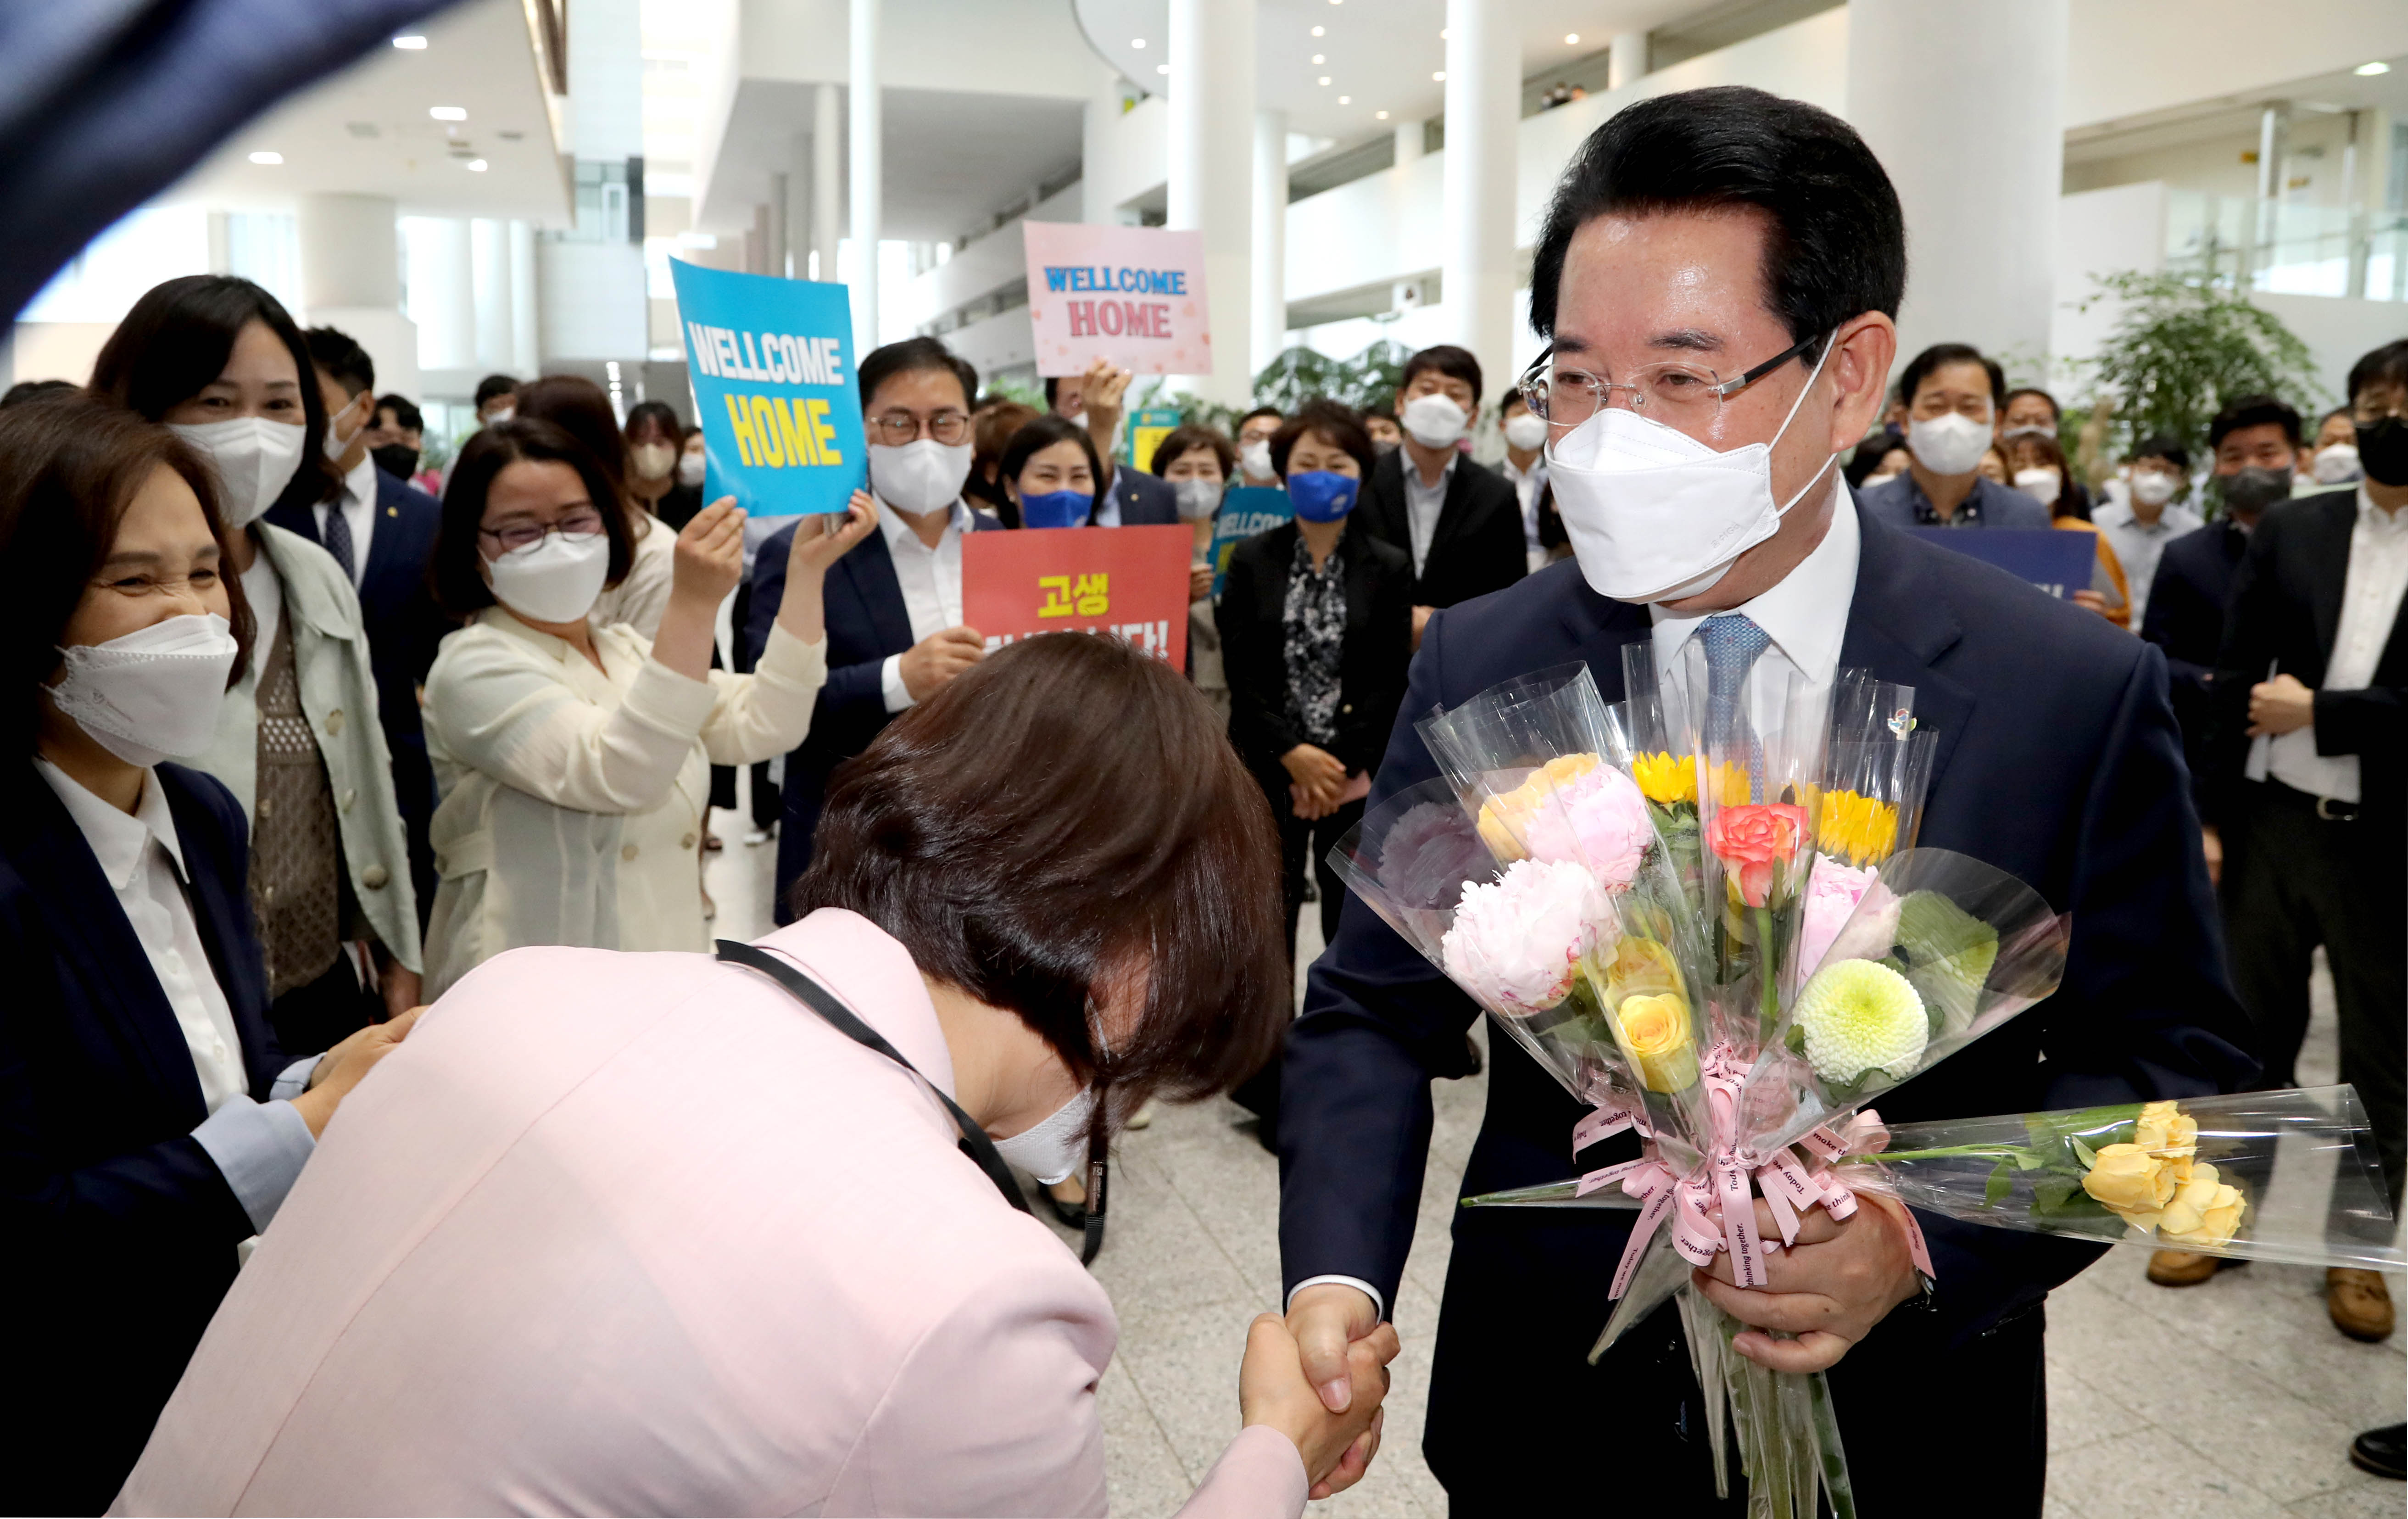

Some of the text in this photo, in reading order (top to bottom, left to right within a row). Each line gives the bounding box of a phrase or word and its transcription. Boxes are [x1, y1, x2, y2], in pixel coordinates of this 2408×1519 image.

[1044, 266, 1187, 295] WELLCOME
[1068, 300, 1172, 338] HOME
[687, 321, 845, 385] WELLCOME
[725, 393, 842, 469] HOME
[1037, 572, 1109, 618] 고생
[1599, 1111, 1628, 1127] together.
[1813, 1132, 1837, 1150] make
[1773, 1160, 1805, 1195] Today we
[1647, 1194, 1670, 1221] together.
[1625, 1247, 1639, 1269] Today
[1736, 1223, 1754, 1285] thinking together.
